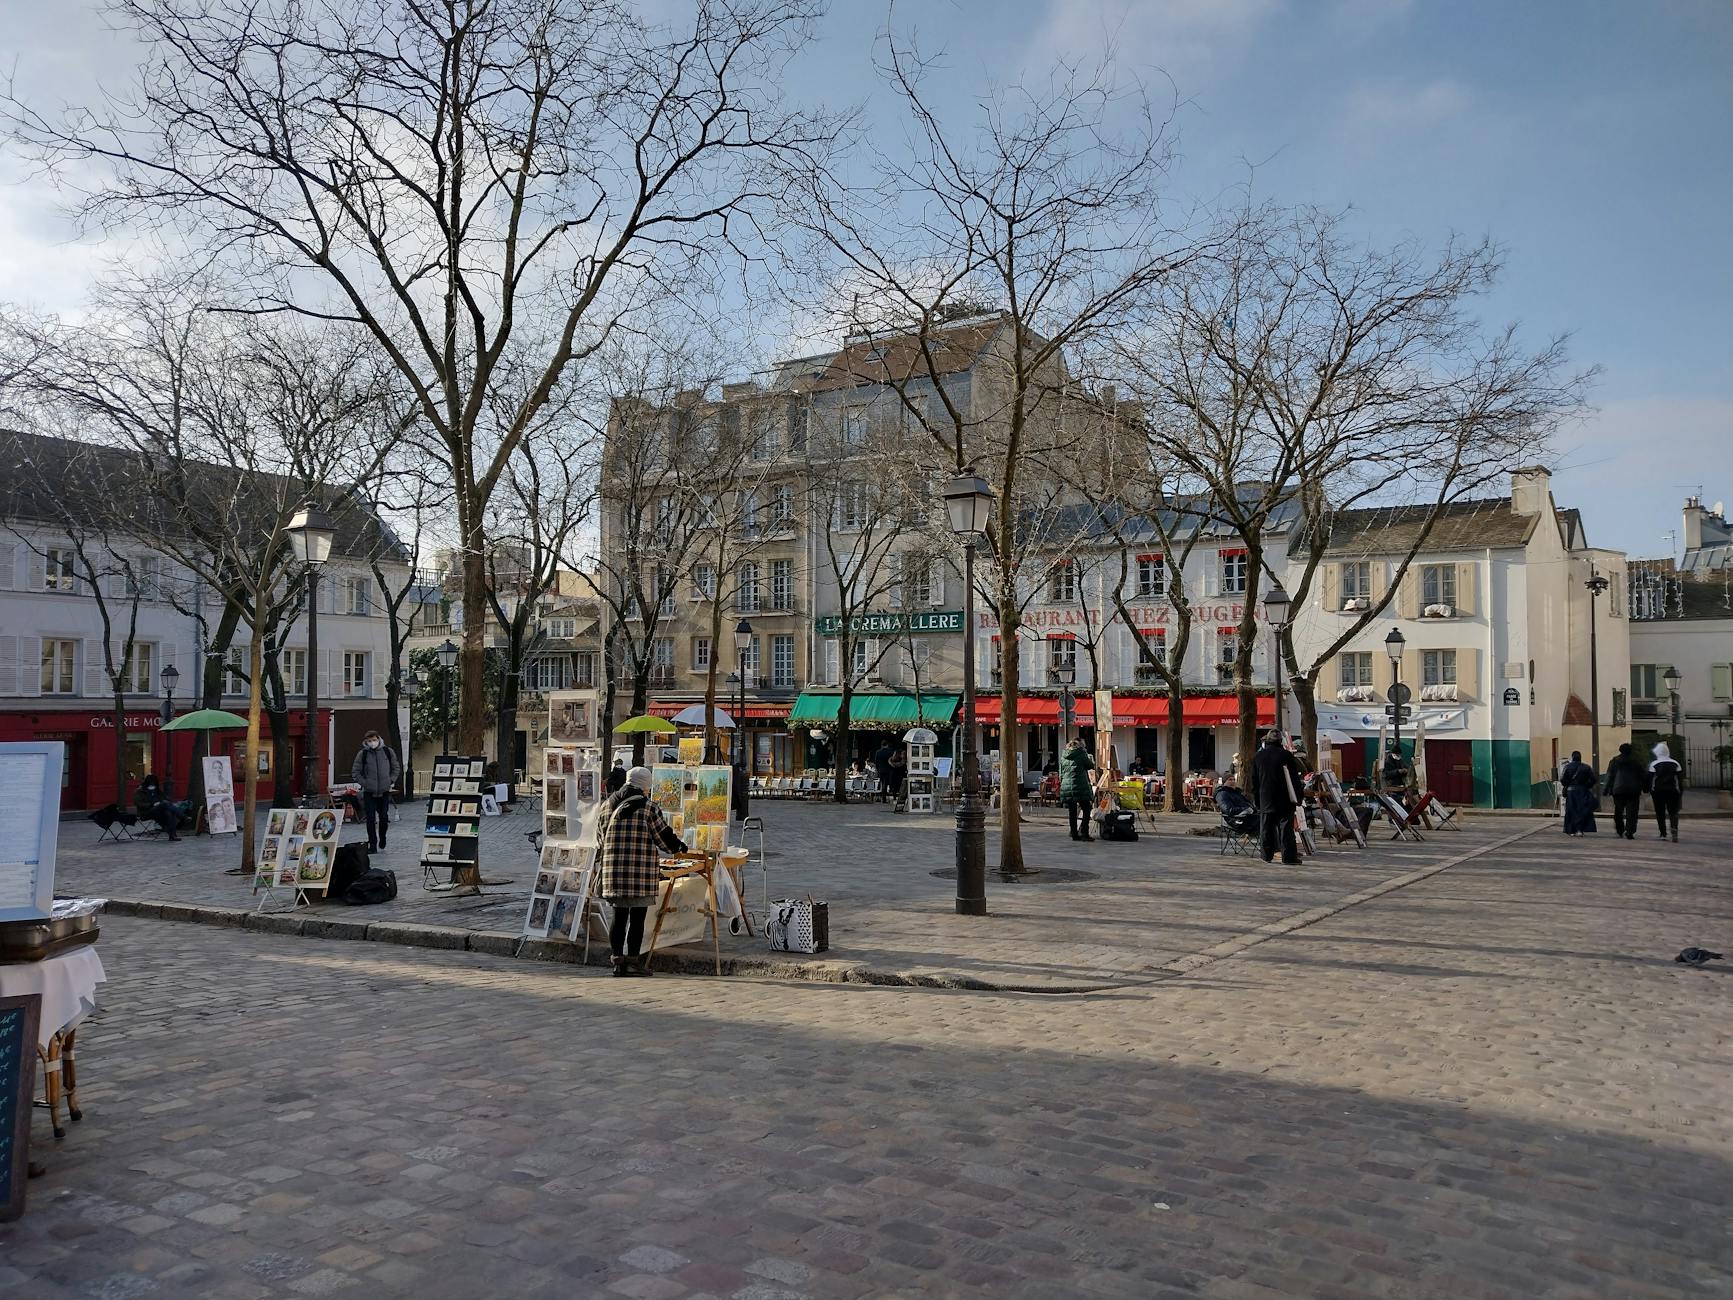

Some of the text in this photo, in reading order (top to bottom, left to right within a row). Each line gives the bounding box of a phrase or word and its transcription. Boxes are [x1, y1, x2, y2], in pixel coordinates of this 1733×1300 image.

[825, 614, 959, 632] LA CREMALLERE
[979, 603, 1269, 628] RAURANT CHEZ EUGÈN
[90, 717, 139, 728] GALRIE
